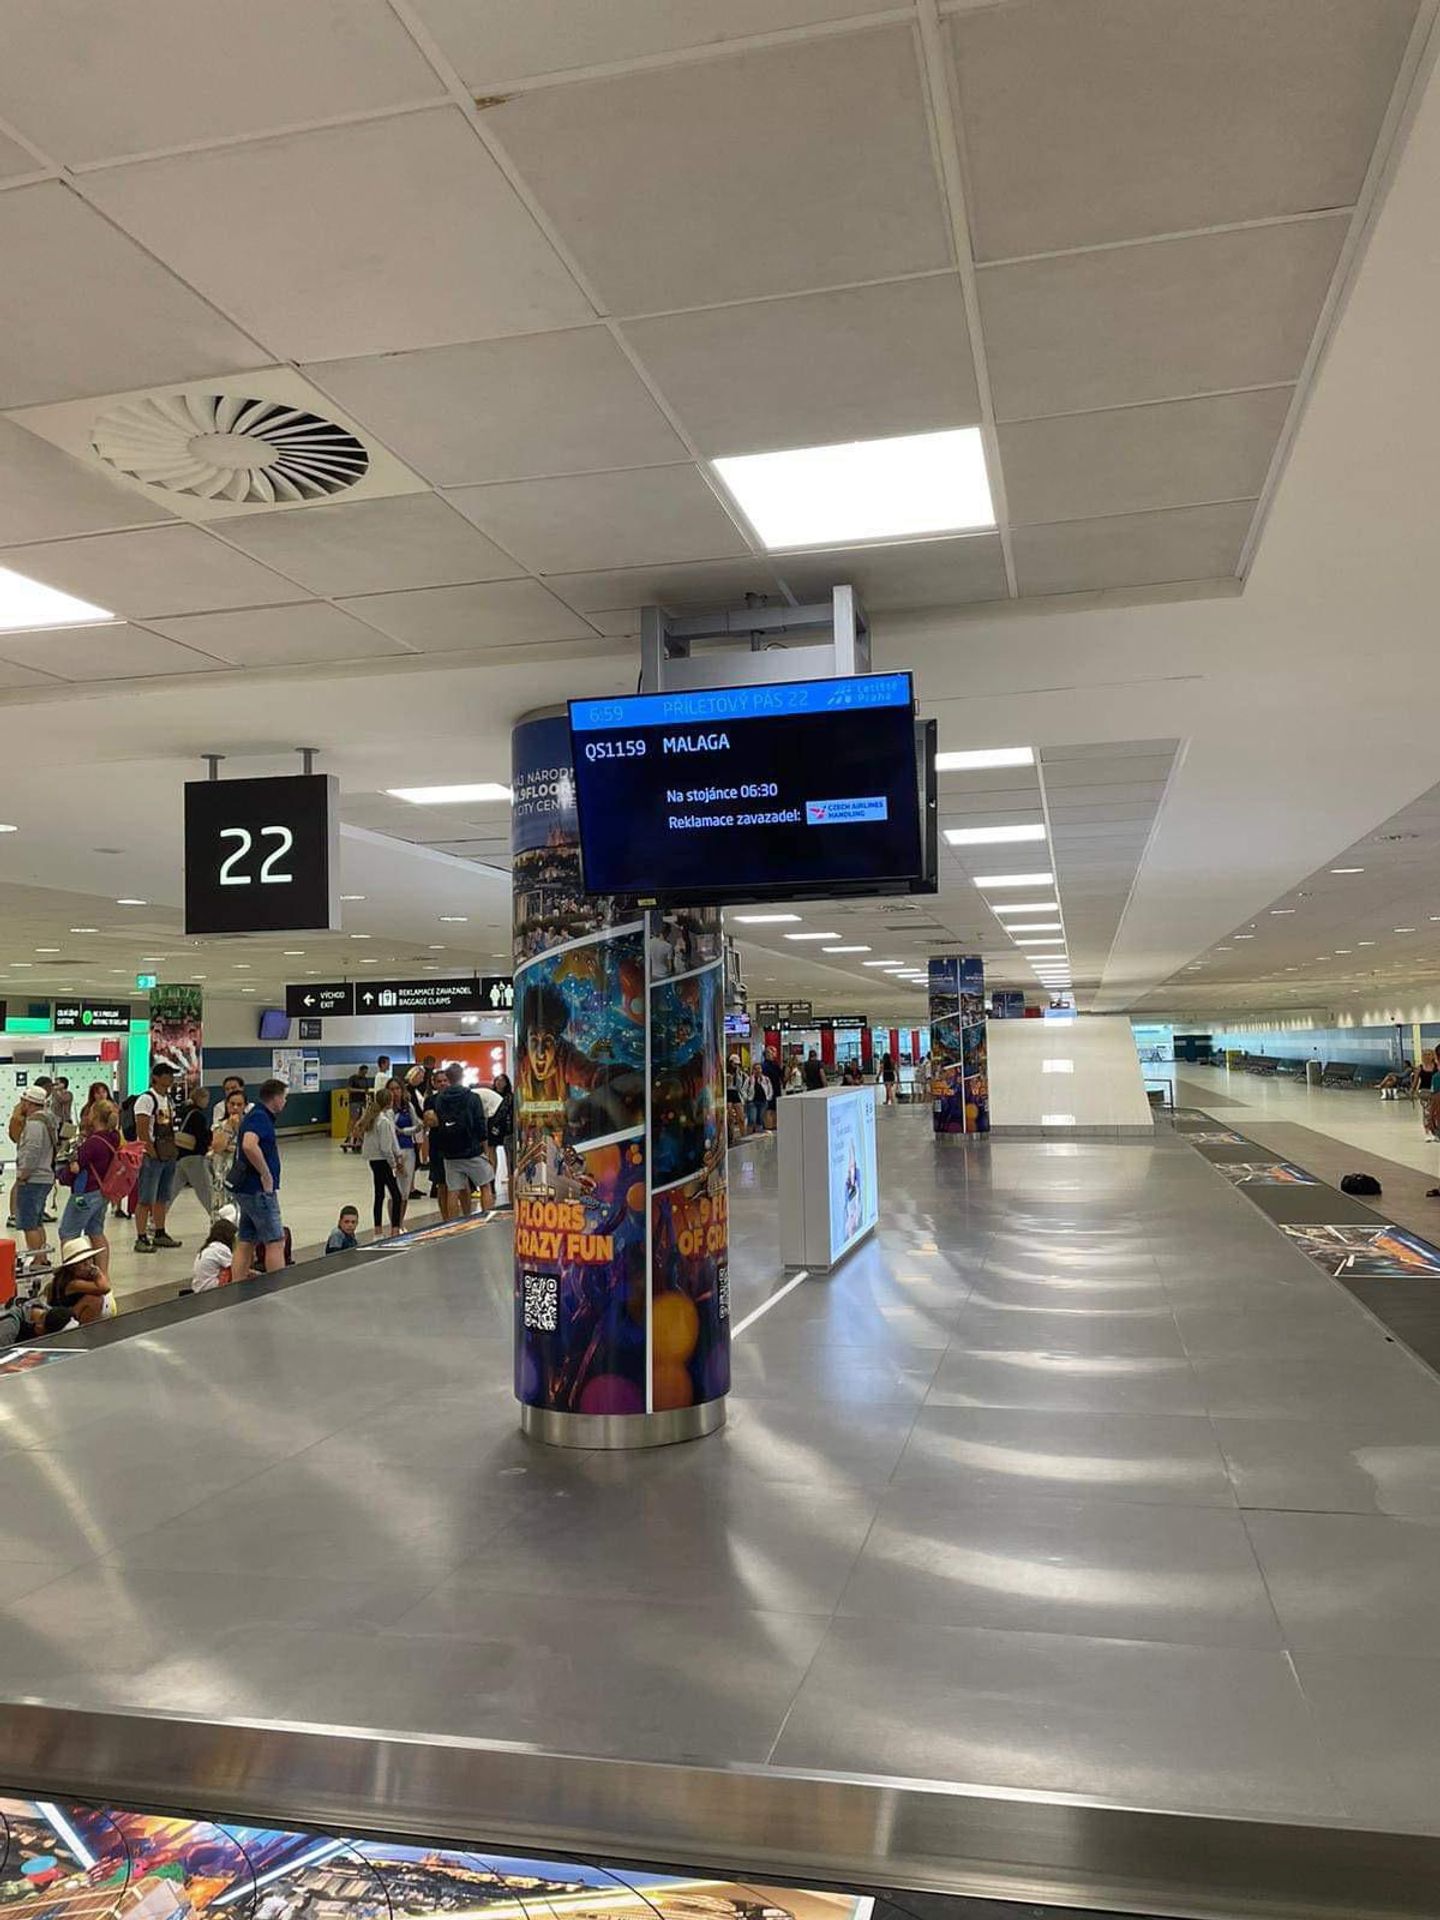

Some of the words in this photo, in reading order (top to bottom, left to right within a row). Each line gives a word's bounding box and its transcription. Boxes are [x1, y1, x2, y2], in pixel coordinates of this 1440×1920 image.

[788, 691, 809, 706] 22
[585, 739, 646, 762] QS1159
[662, 733, 731, 754] MALAGA
[536, 798, 577, 812] CENTE
[666, 789, 684, 803] Na
[685, 786, 738, 803] stojánce
[740, 783, 778, 798] 06:30
[669, 815, 734, 829] Reklamace
[736, 808, 801, 825] zavazadel:
[219, 825, 293, 886] 22
[519, 1199, 587, 1231] FLOORS
[517, 1229, 563, 1259] CRAZY
[566, 1232, 615, 1261] FUN
[678, 1228, 704, 1256] OF
